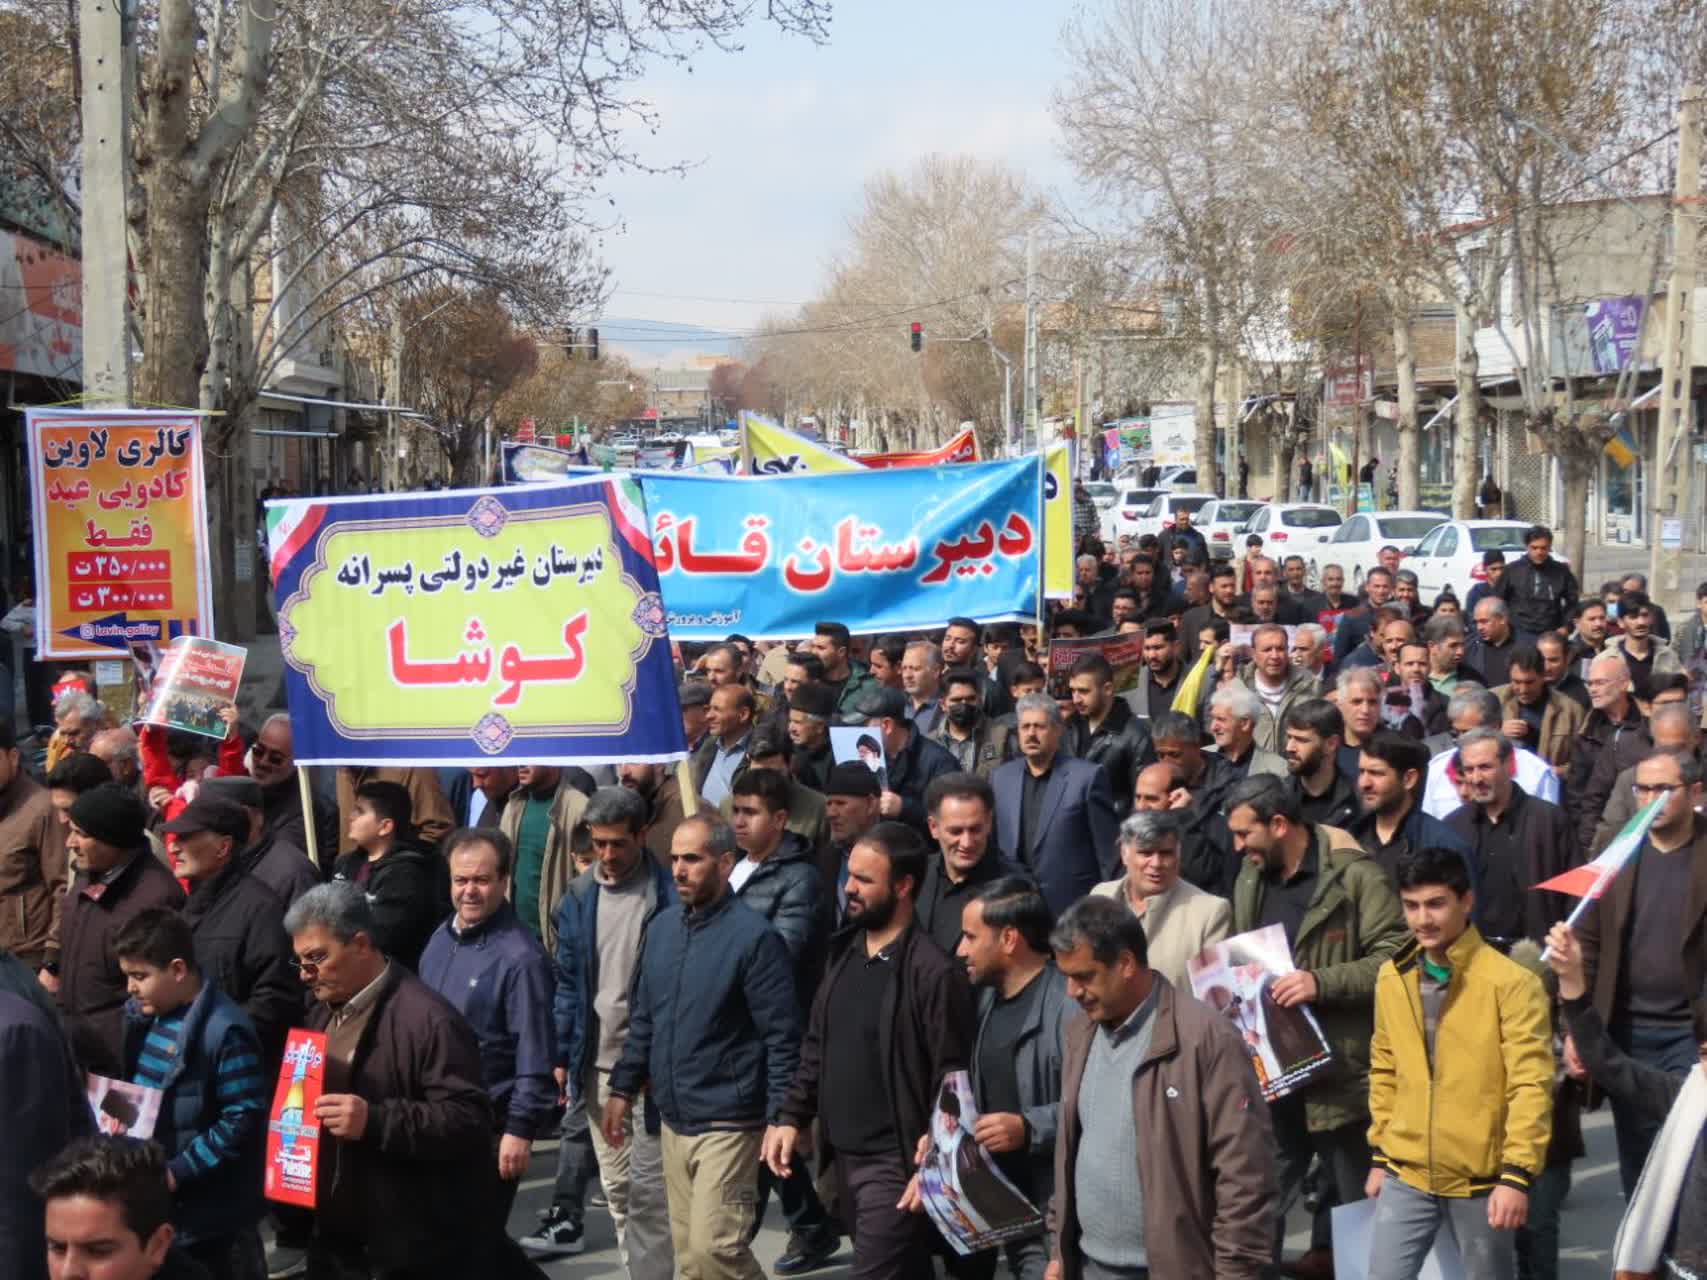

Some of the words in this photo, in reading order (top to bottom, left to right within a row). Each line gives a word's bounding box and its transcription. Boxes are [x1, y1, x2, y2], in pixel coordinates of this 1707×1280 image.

[44, 429, 109, 468] لاوین
[48, 480, 89, 509] عید
[99, 471, 188, 510] کادویی
[85, 516, 153, 547] فقط
[654, 512, 768, 574] قائ
[531, 544, 603, 586] دبیرستان
[784, 513, 1032, 591] دبیرستان
[337, 555, 414, 595] پسرانه
[387, 612, 589, 705] کوشا
